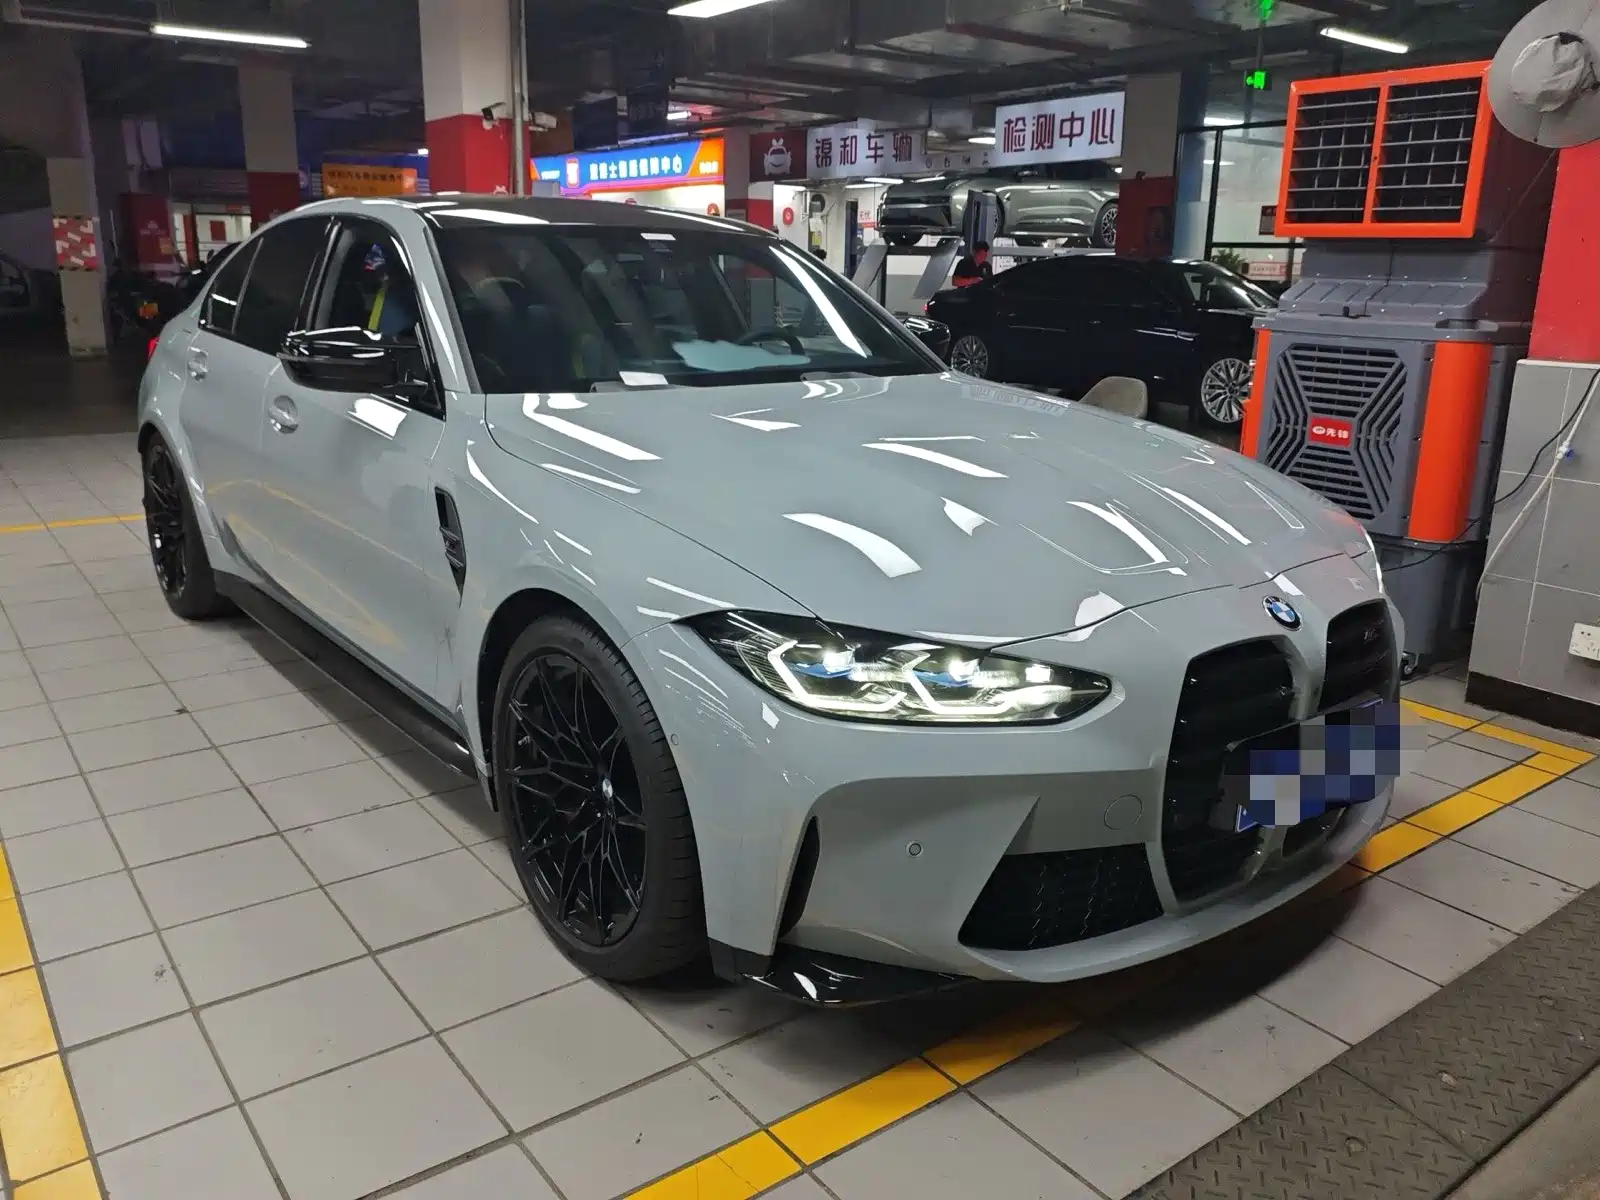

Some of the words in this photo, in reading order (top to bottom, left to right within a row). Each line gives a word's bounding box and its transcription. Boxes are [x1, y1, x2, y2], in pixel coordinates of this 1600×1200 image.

[815, 131, 912, 168] 锦和车辆
[1003, 107, 1115, 153] 检测中心
